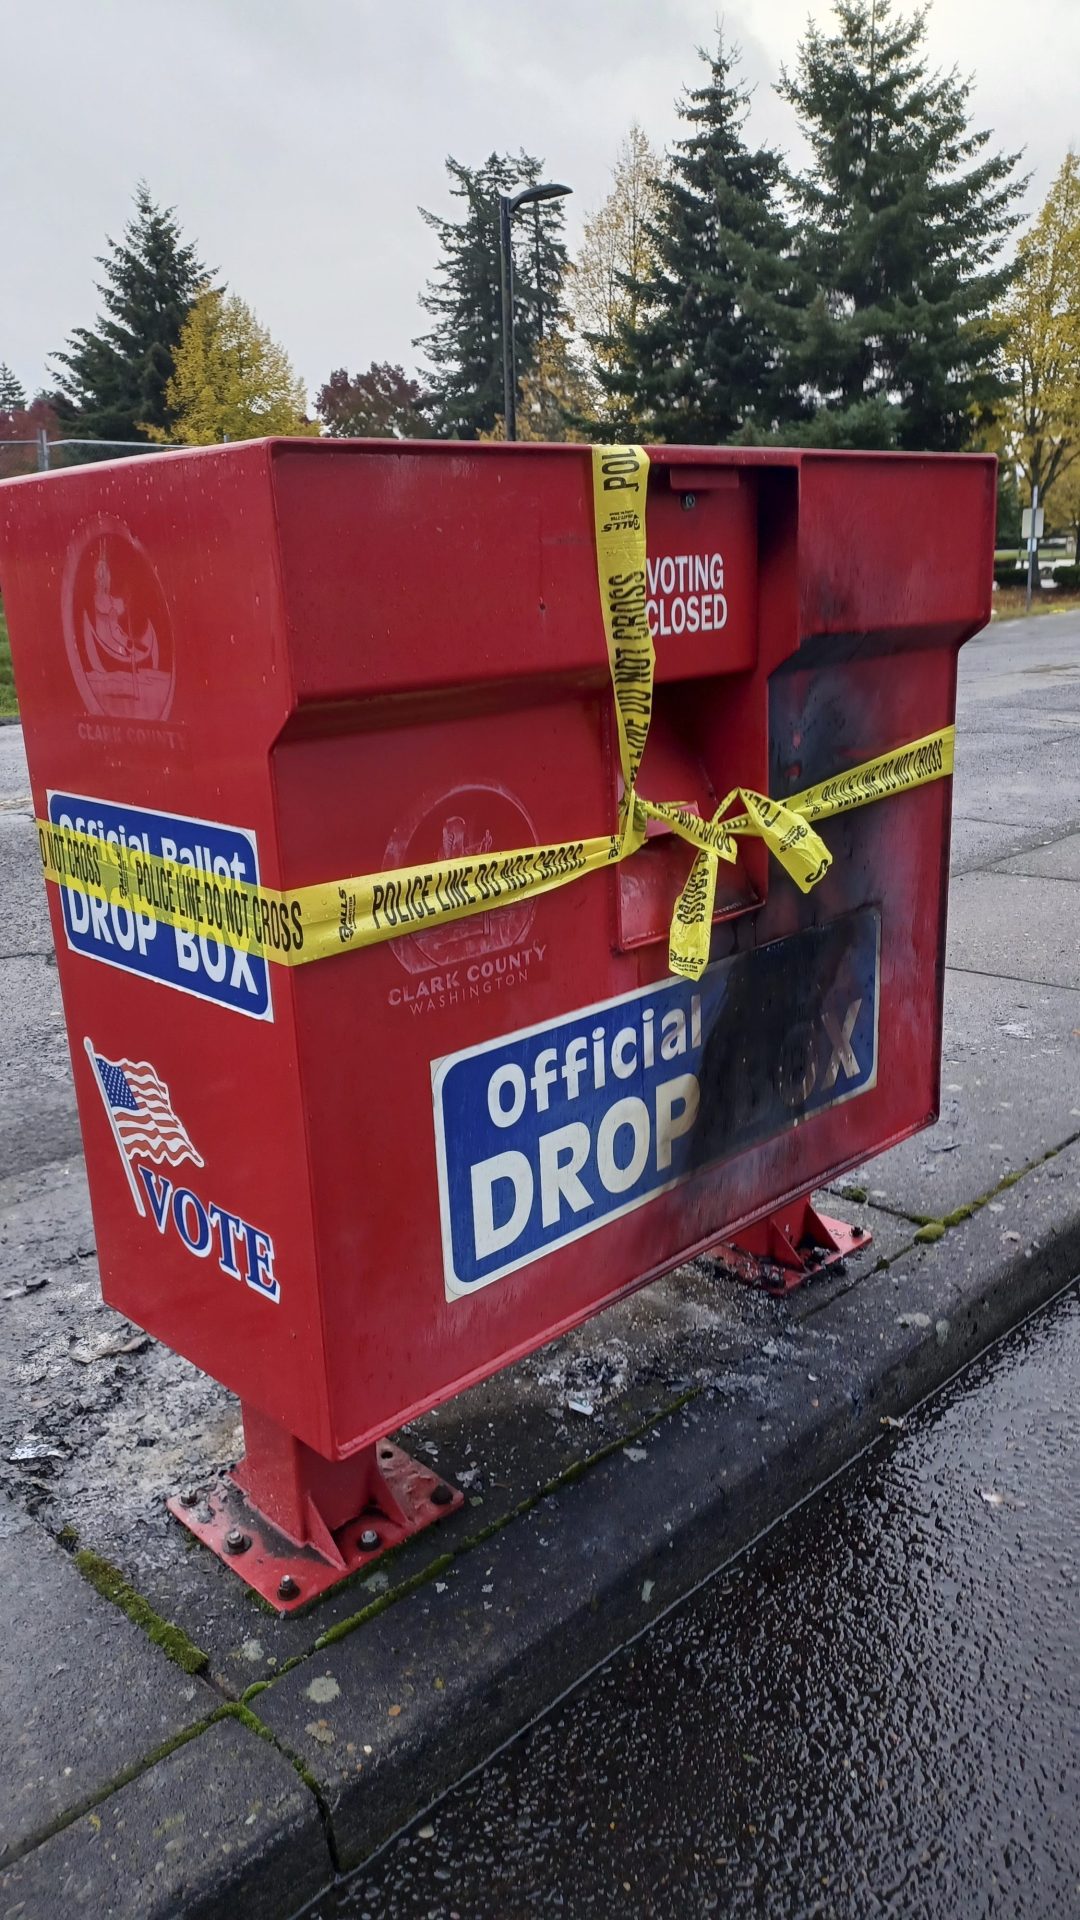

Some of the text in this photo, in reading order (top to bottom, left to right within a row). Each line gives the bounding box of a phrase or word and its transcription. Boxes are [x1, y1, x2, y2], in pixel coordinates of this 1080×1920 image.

[608, 571, 650, 640] CROSS
[646, 552, 724, 596] VOTING
[646, 593, 728, 637] CLOSED
[614, 647, 651, 684] NOT
[616, 688, 651, 715] DO
[821, 773, 863, 810] POLICE
[856, 765, 884, 799] LINE
[877, 758, 898, 791] DO
[892, 750, 915, 786] NOT
[912, 738, 944, 779] CROSS
[46, 831, 67, 875] NOT
[67, 837, 102, 888] CROSS
[59, 813, 151, 879] Official
[134, 859, 176, 914] POLICE
[174, 873, 204, 922] LINE
[203, 883, 223, 930] DO
[223, 890, 250, 939] NOT
[251, 899, 304, 952] CROSS
[372, 874, 436, 929] POLICE
[435, 866, 477, 912] LINE
[474, 860, 502, 900] DO
[500, 853, 535, 892] NOT
[532, 843, 587, 881] CROSS
[677, 868, 709, 925] CROSS
[65, 873, 158, 956] DROP
[172, 908, 259, 995] BOX
[388, 943, 547, 1006] CLARK COUNTY
[409, 969, 529, 1016] WASHINGTON
[487, 994, 701, 1128] Official
[470, 1072, 701, 1261] DROP
[138, 1164, 281, 1304] VOTE
